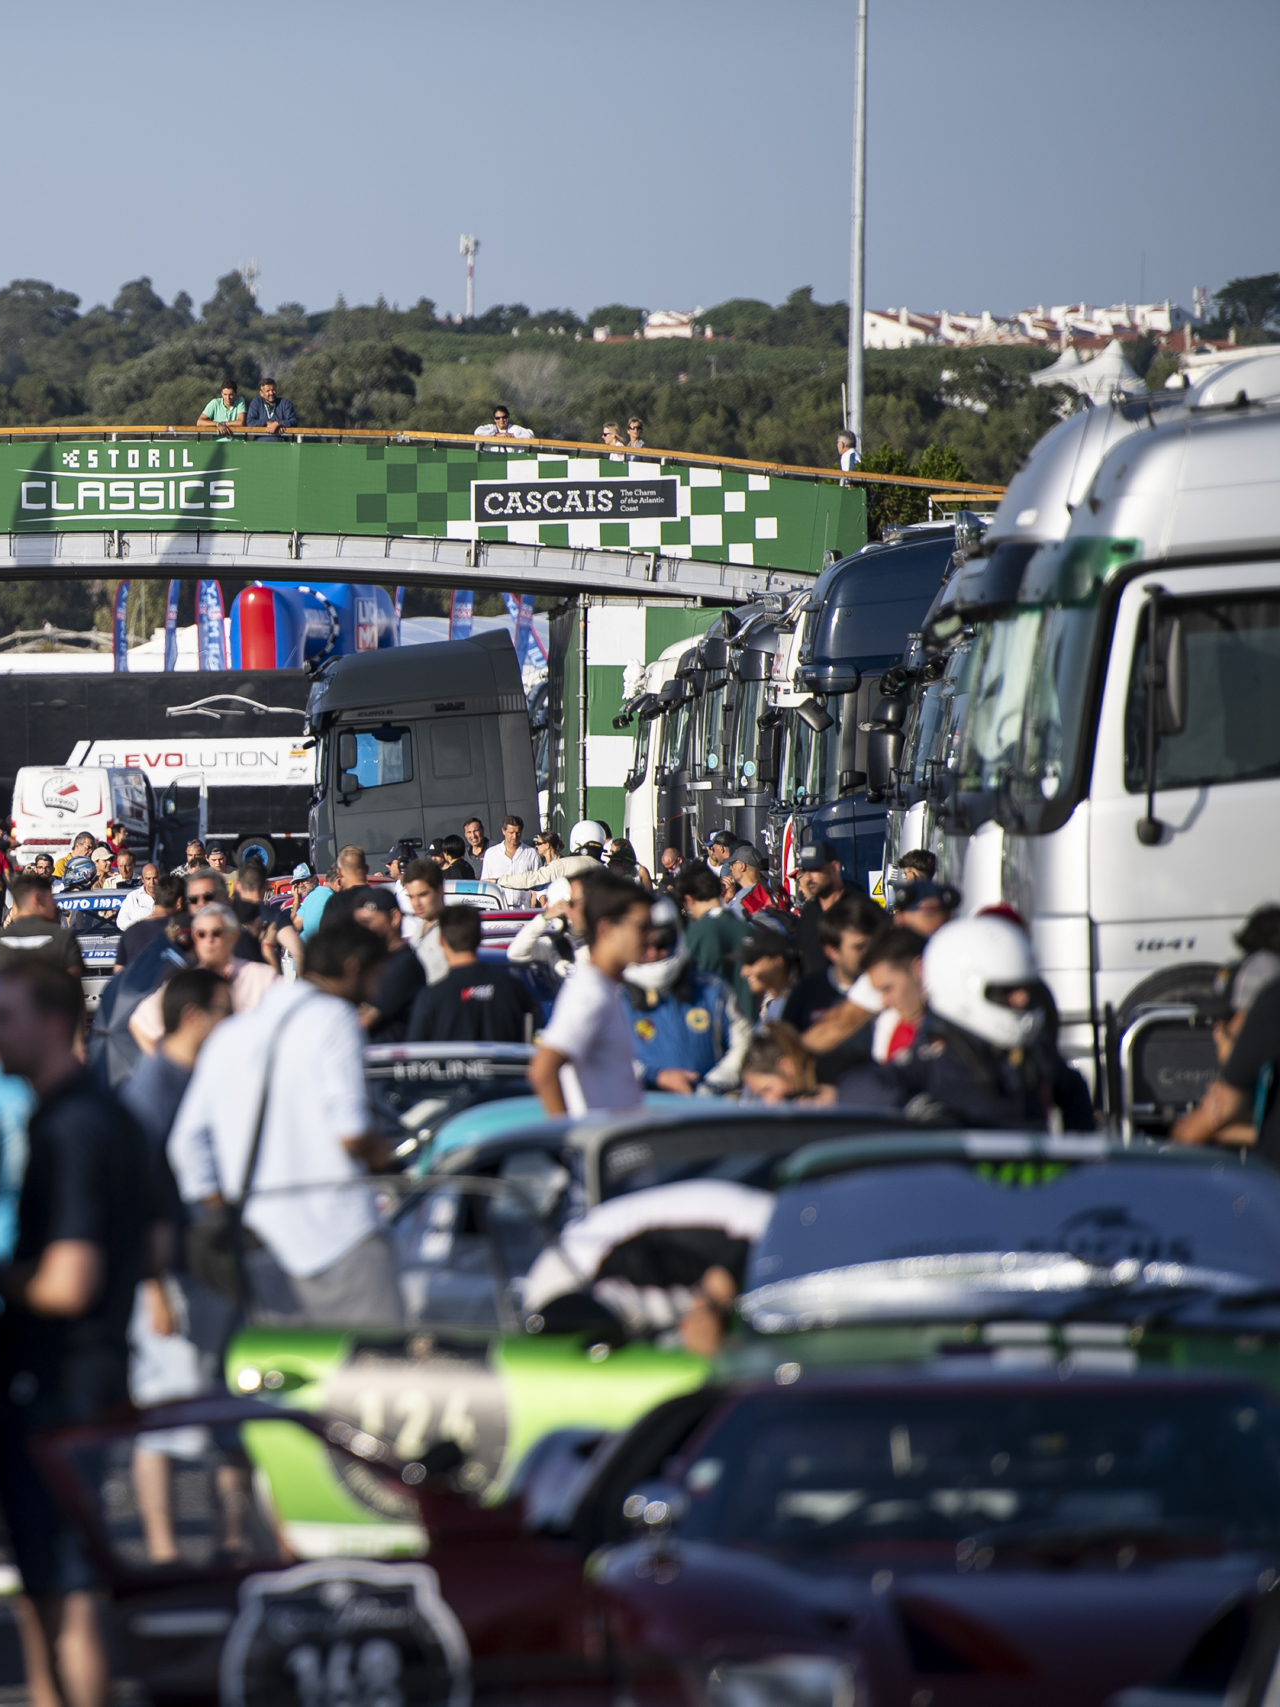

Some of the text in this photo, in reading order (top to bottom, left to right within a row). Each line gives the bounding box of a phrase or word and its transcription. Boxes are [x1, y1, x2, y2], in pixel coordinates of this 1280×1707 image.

[62, 449, 193, 468] ESTORIL
[21, 480, 235, 510] CLASSICS
[620, 488, 657, 497] The Charm
[627, 497, 638, 505] the
[639, 496, 665, 504] Atlantic
[483, 489, 614, 515] CASCAIS
[98, 750, 279, 768] R-EVOLUTION
